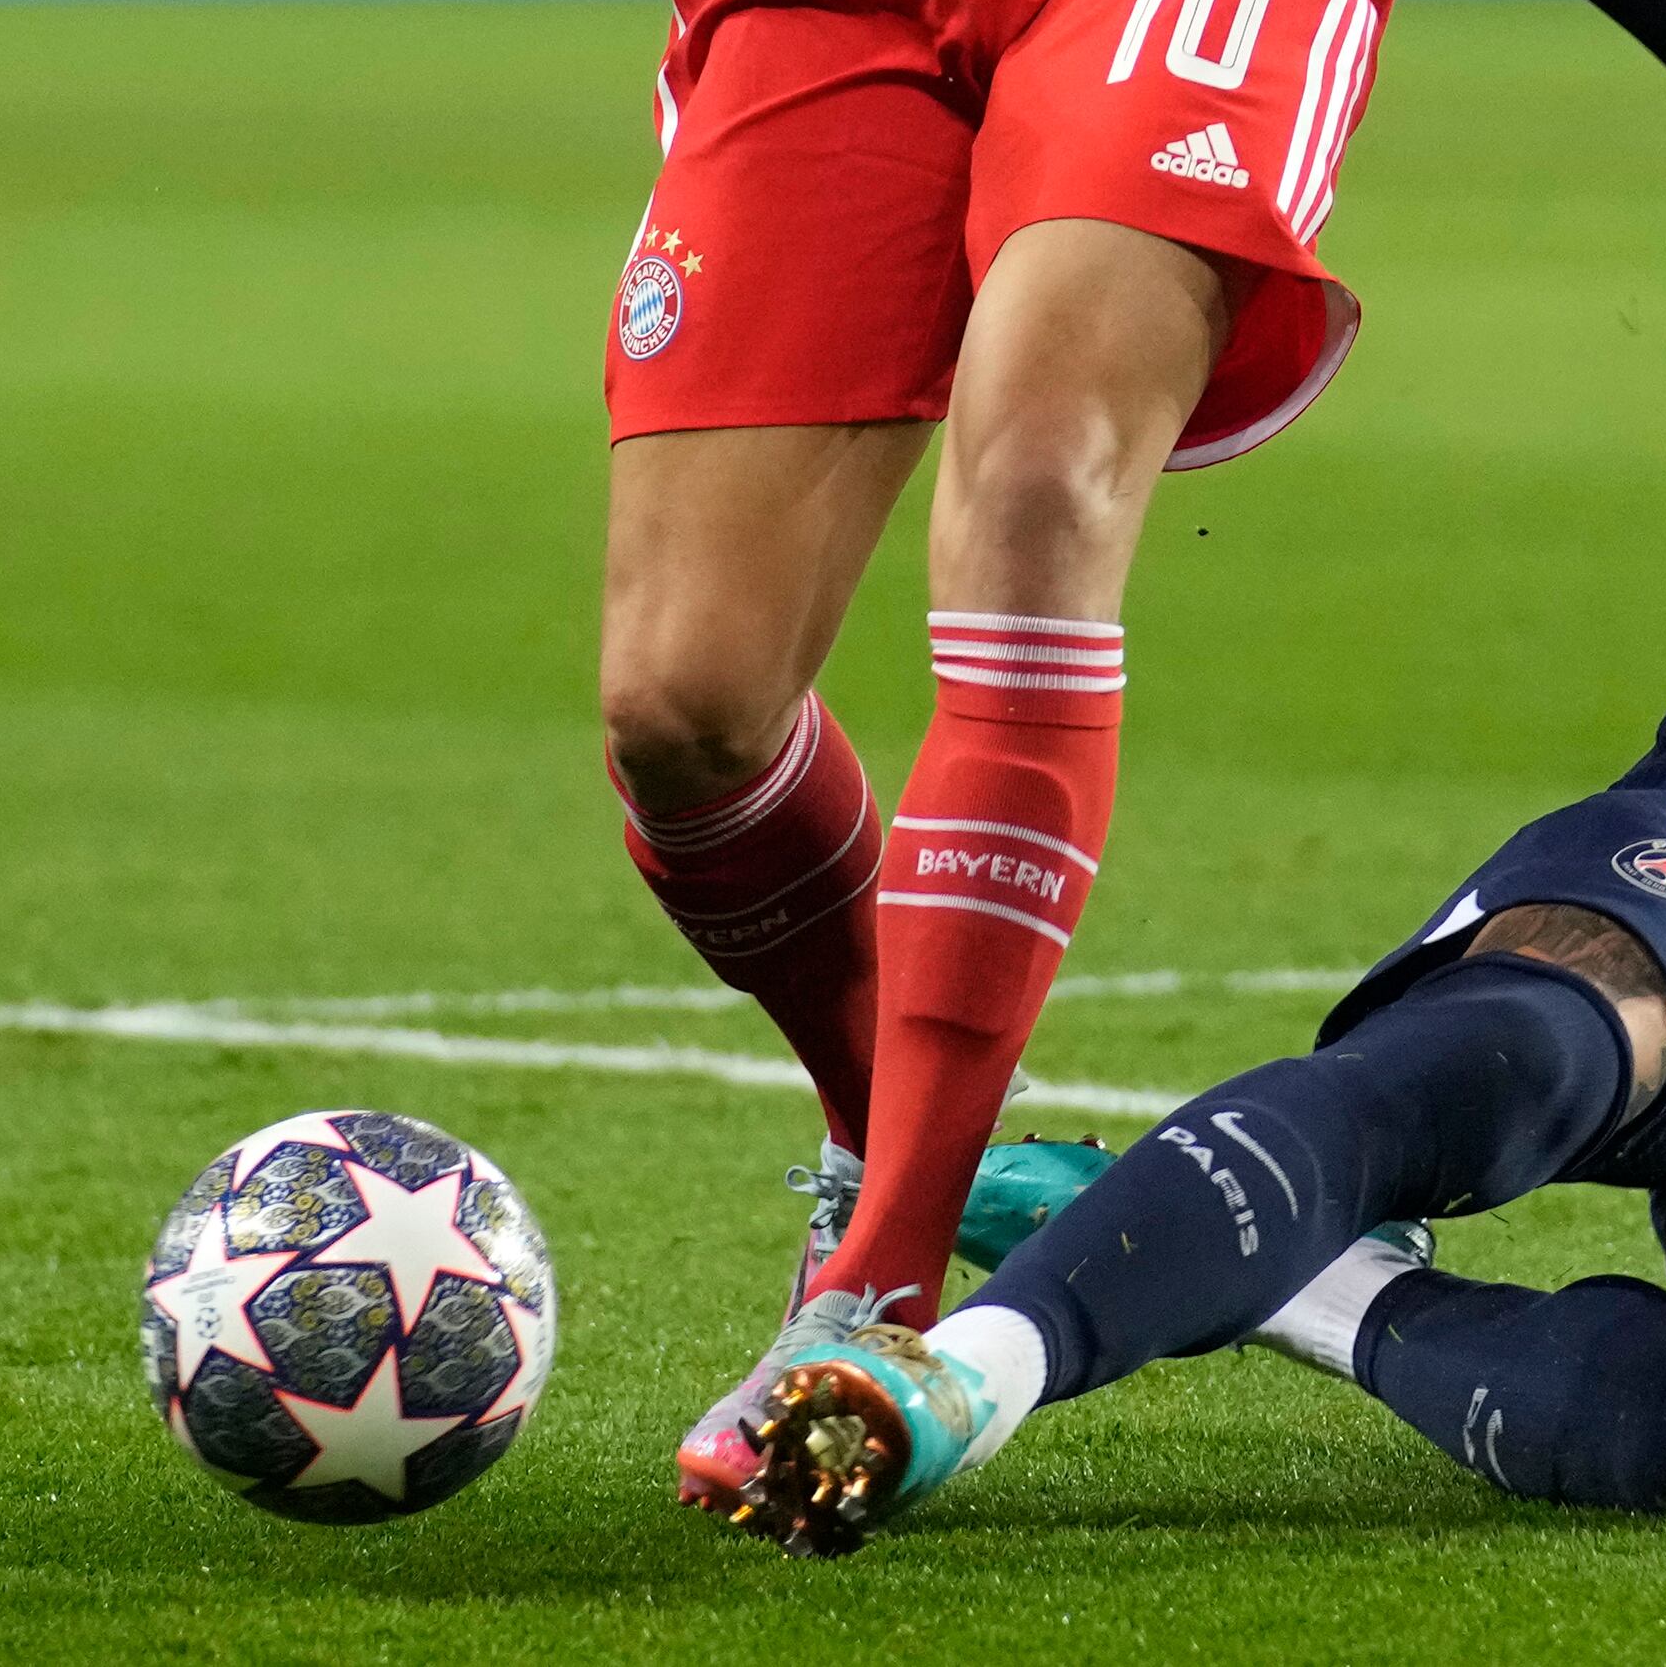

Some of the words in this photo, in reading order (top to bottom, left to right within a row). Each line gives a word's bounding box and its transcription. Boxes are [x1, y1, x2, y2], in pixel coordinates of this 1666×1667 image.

[1150, 151, 1250, 189] adidas
[635, 263, 675, 298] BAYERN
[915, 847, 1067, 905] BAYERN
[1157, 1125, 1260, 1258] PARIS
